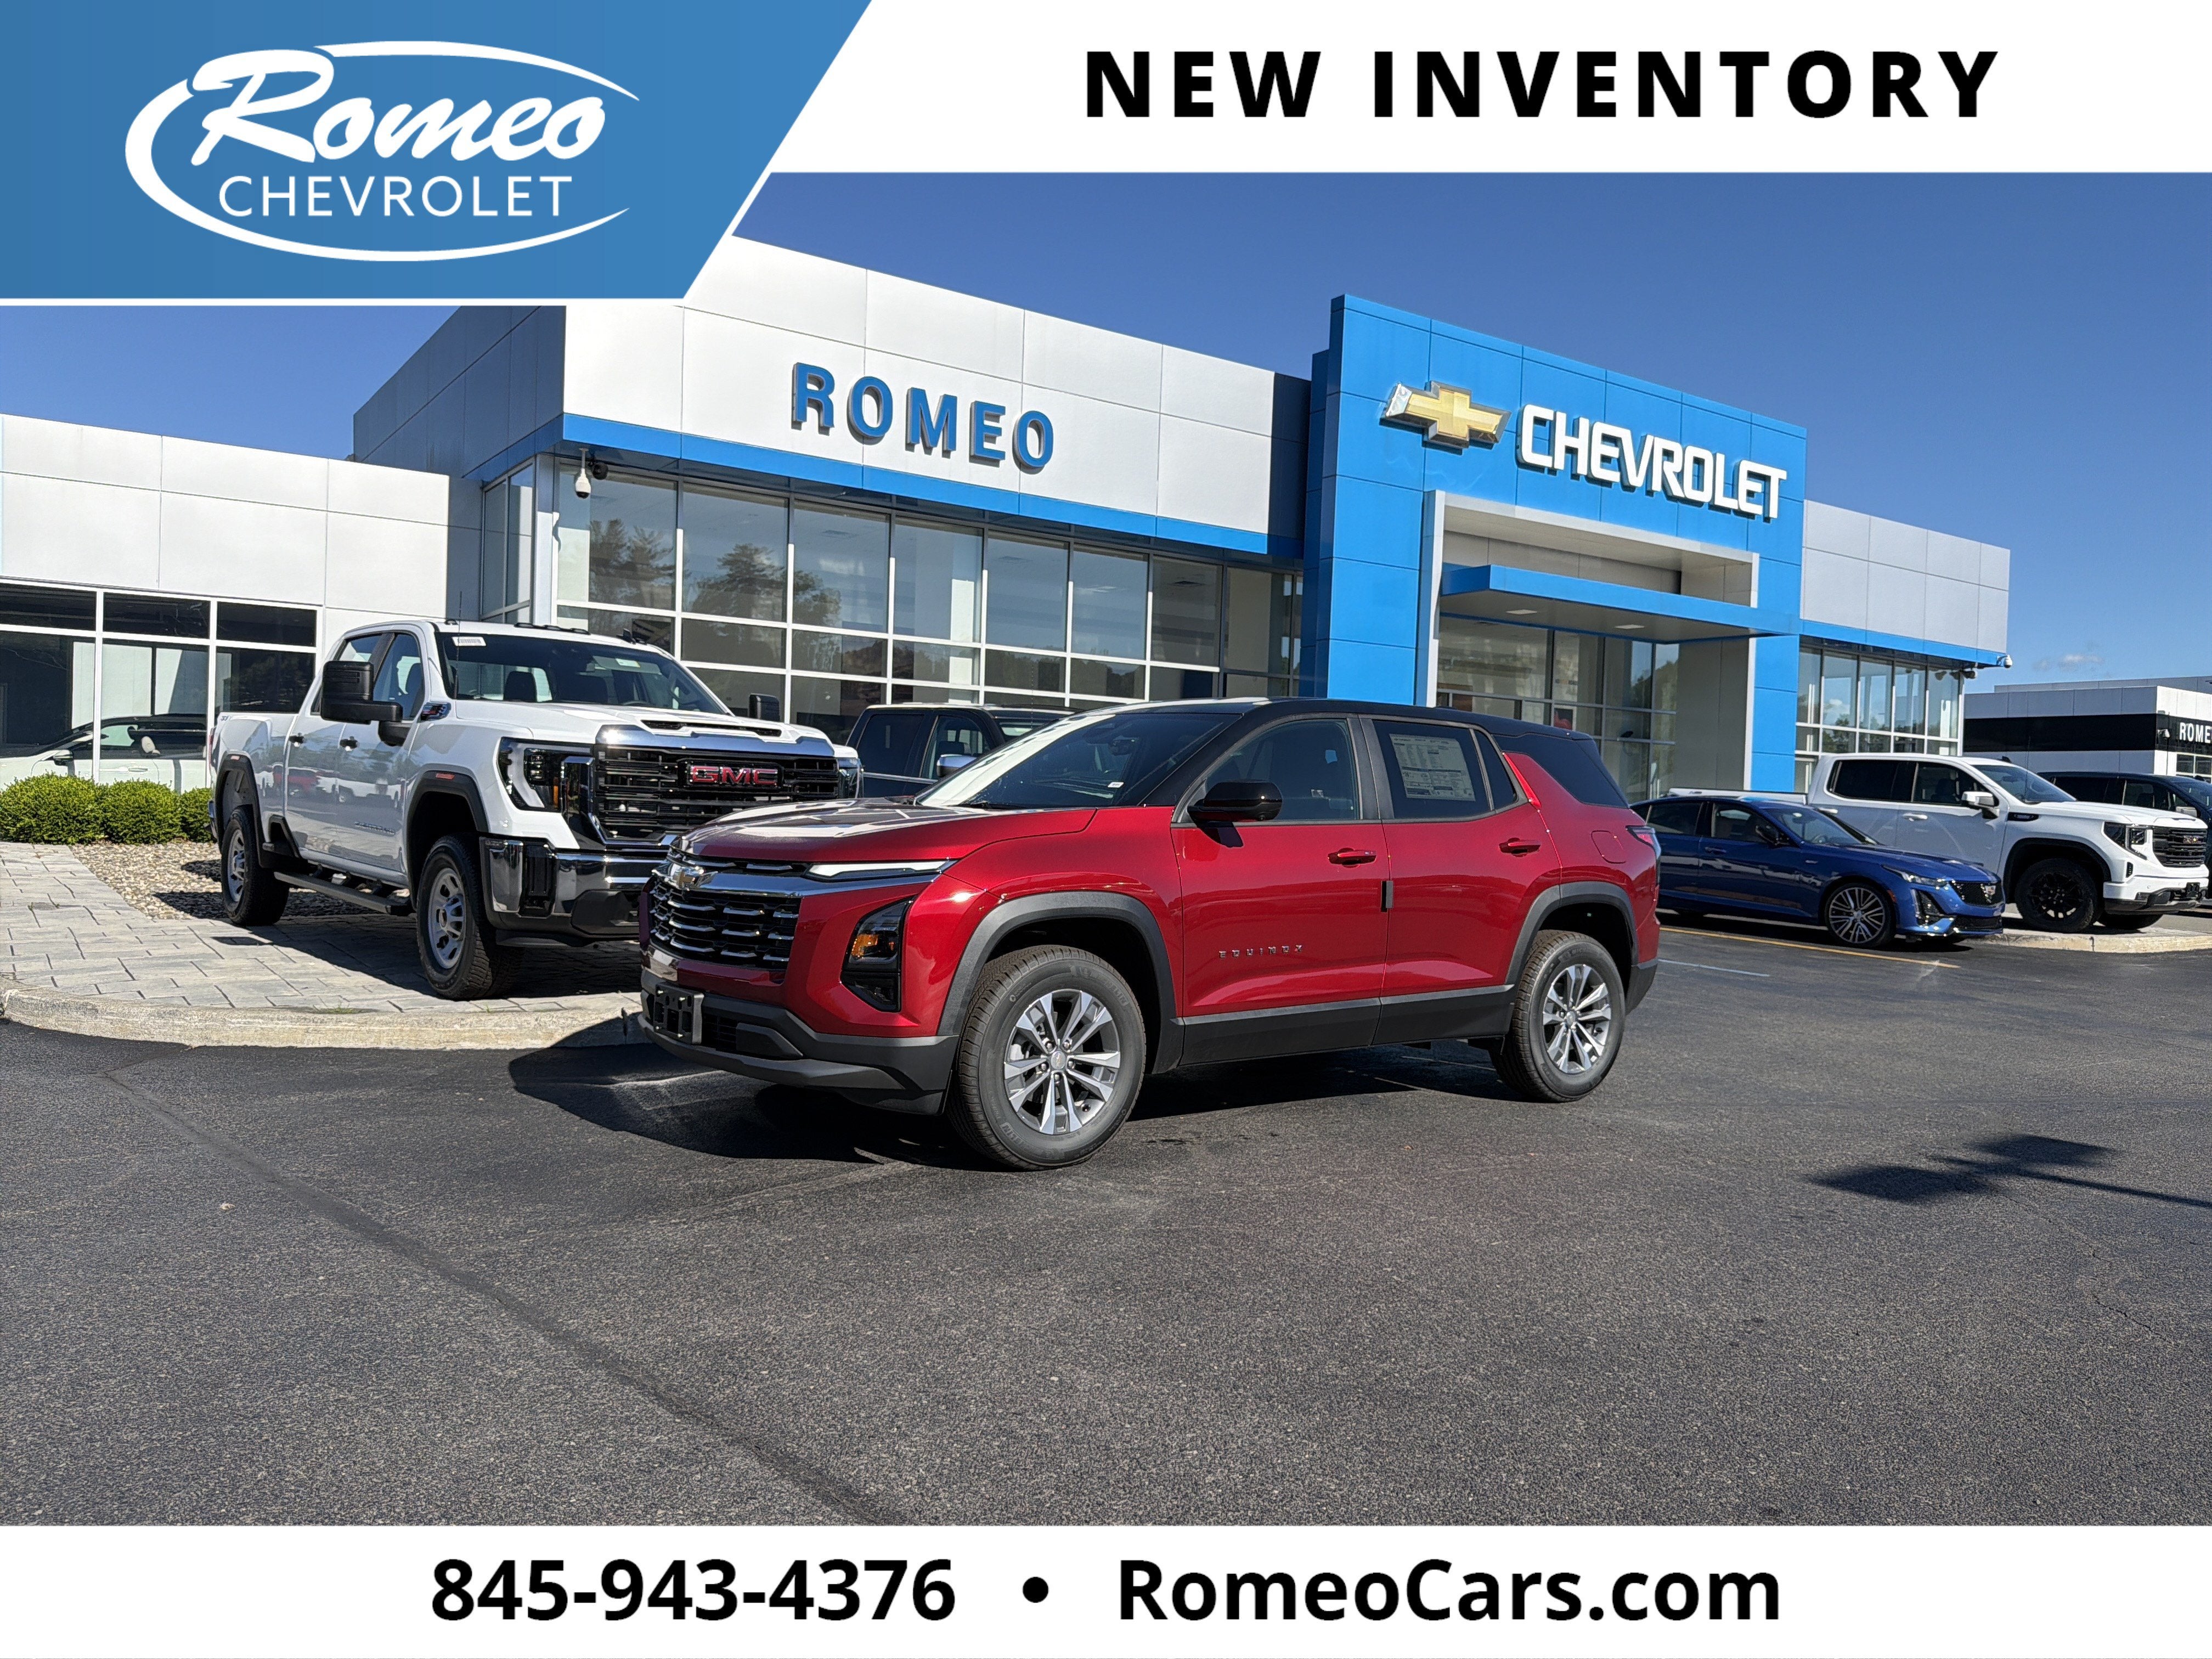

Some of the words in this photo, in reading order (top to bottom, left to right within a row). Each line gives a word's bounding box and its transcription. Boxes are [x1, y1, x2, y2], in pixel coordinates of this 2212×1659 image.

[791, 362, 1054, 475] ROMEO
[1516, 404, 1787, 523] CHEVROLET
[2179, 722, 2212, 744] ROME
[691, 765, 778, 785] GMC
[1218, 944, 1303, 959] EQUINOX
